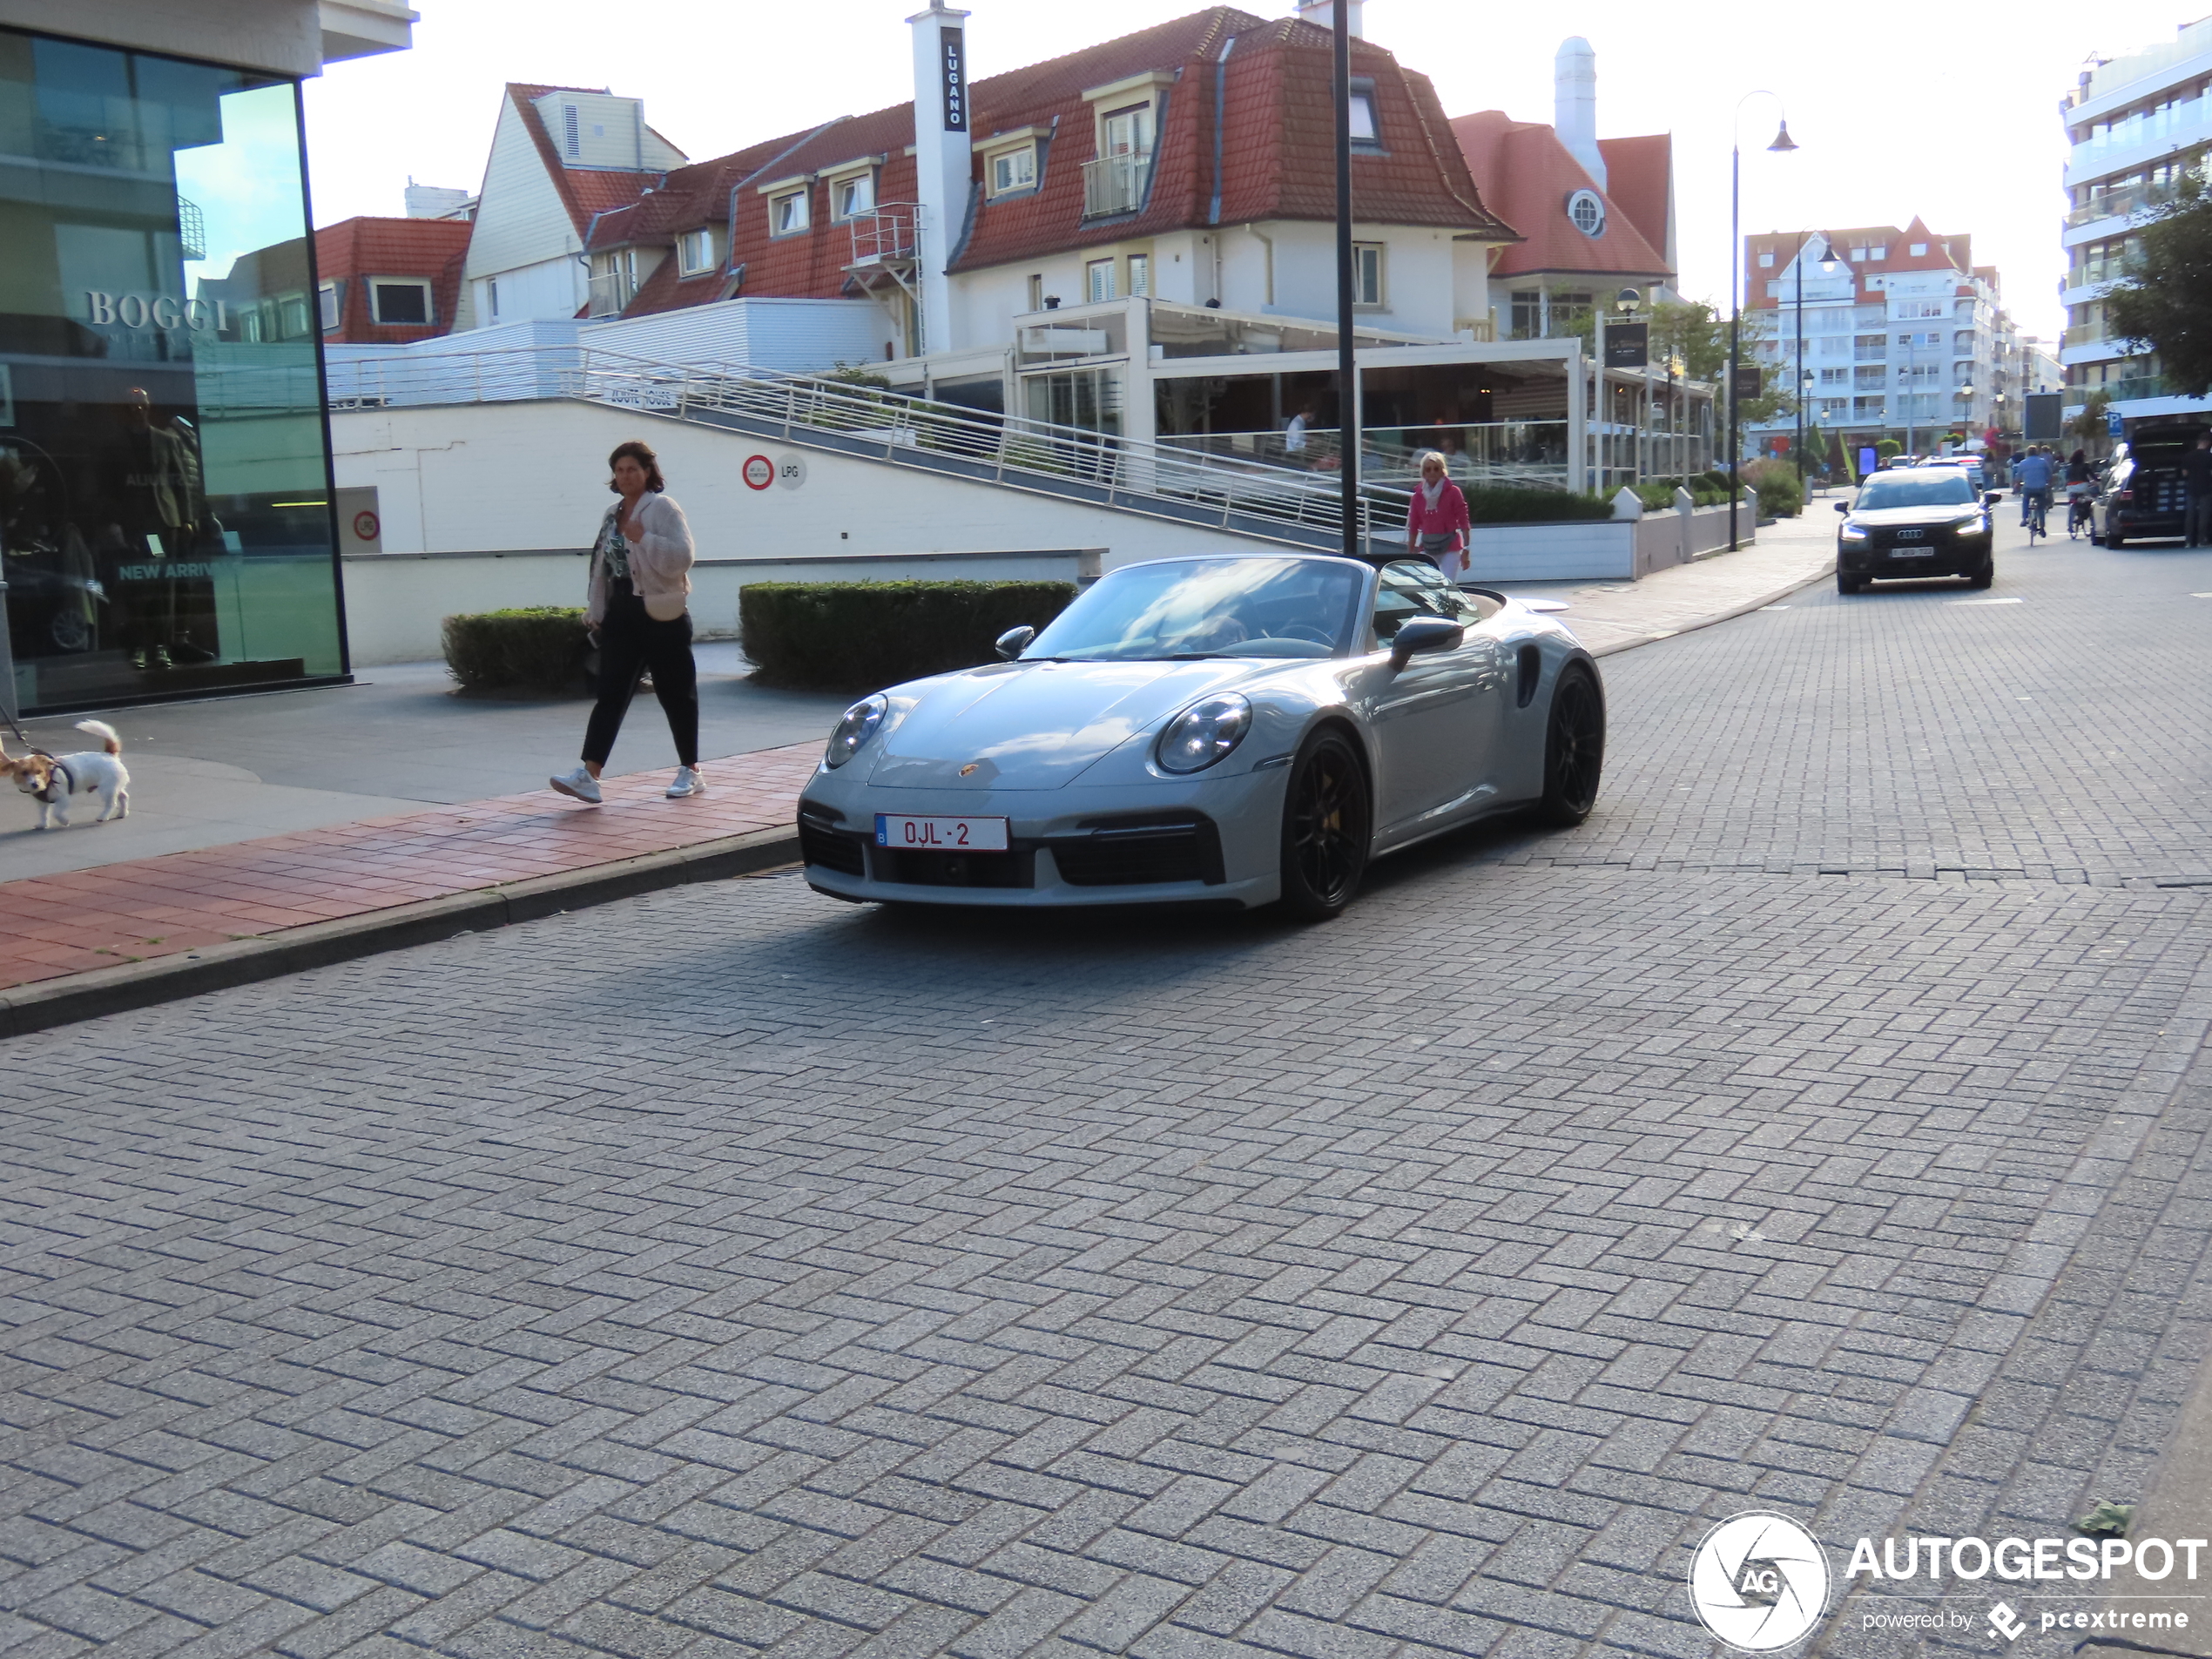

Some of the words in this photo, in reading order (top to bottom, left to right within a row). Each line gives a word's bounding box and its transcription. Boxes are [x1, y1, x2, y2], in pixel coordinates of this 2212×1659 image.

[948, 45, 961, 124] LUGANO
[86, 291, 230, 332] BOGGI
[2109, 414, 2120, 428] P
[781, 465, 799, 478] LPG
[119, 564, 159, 581] NEW
[165, 562, 245, 578] ARRIV
